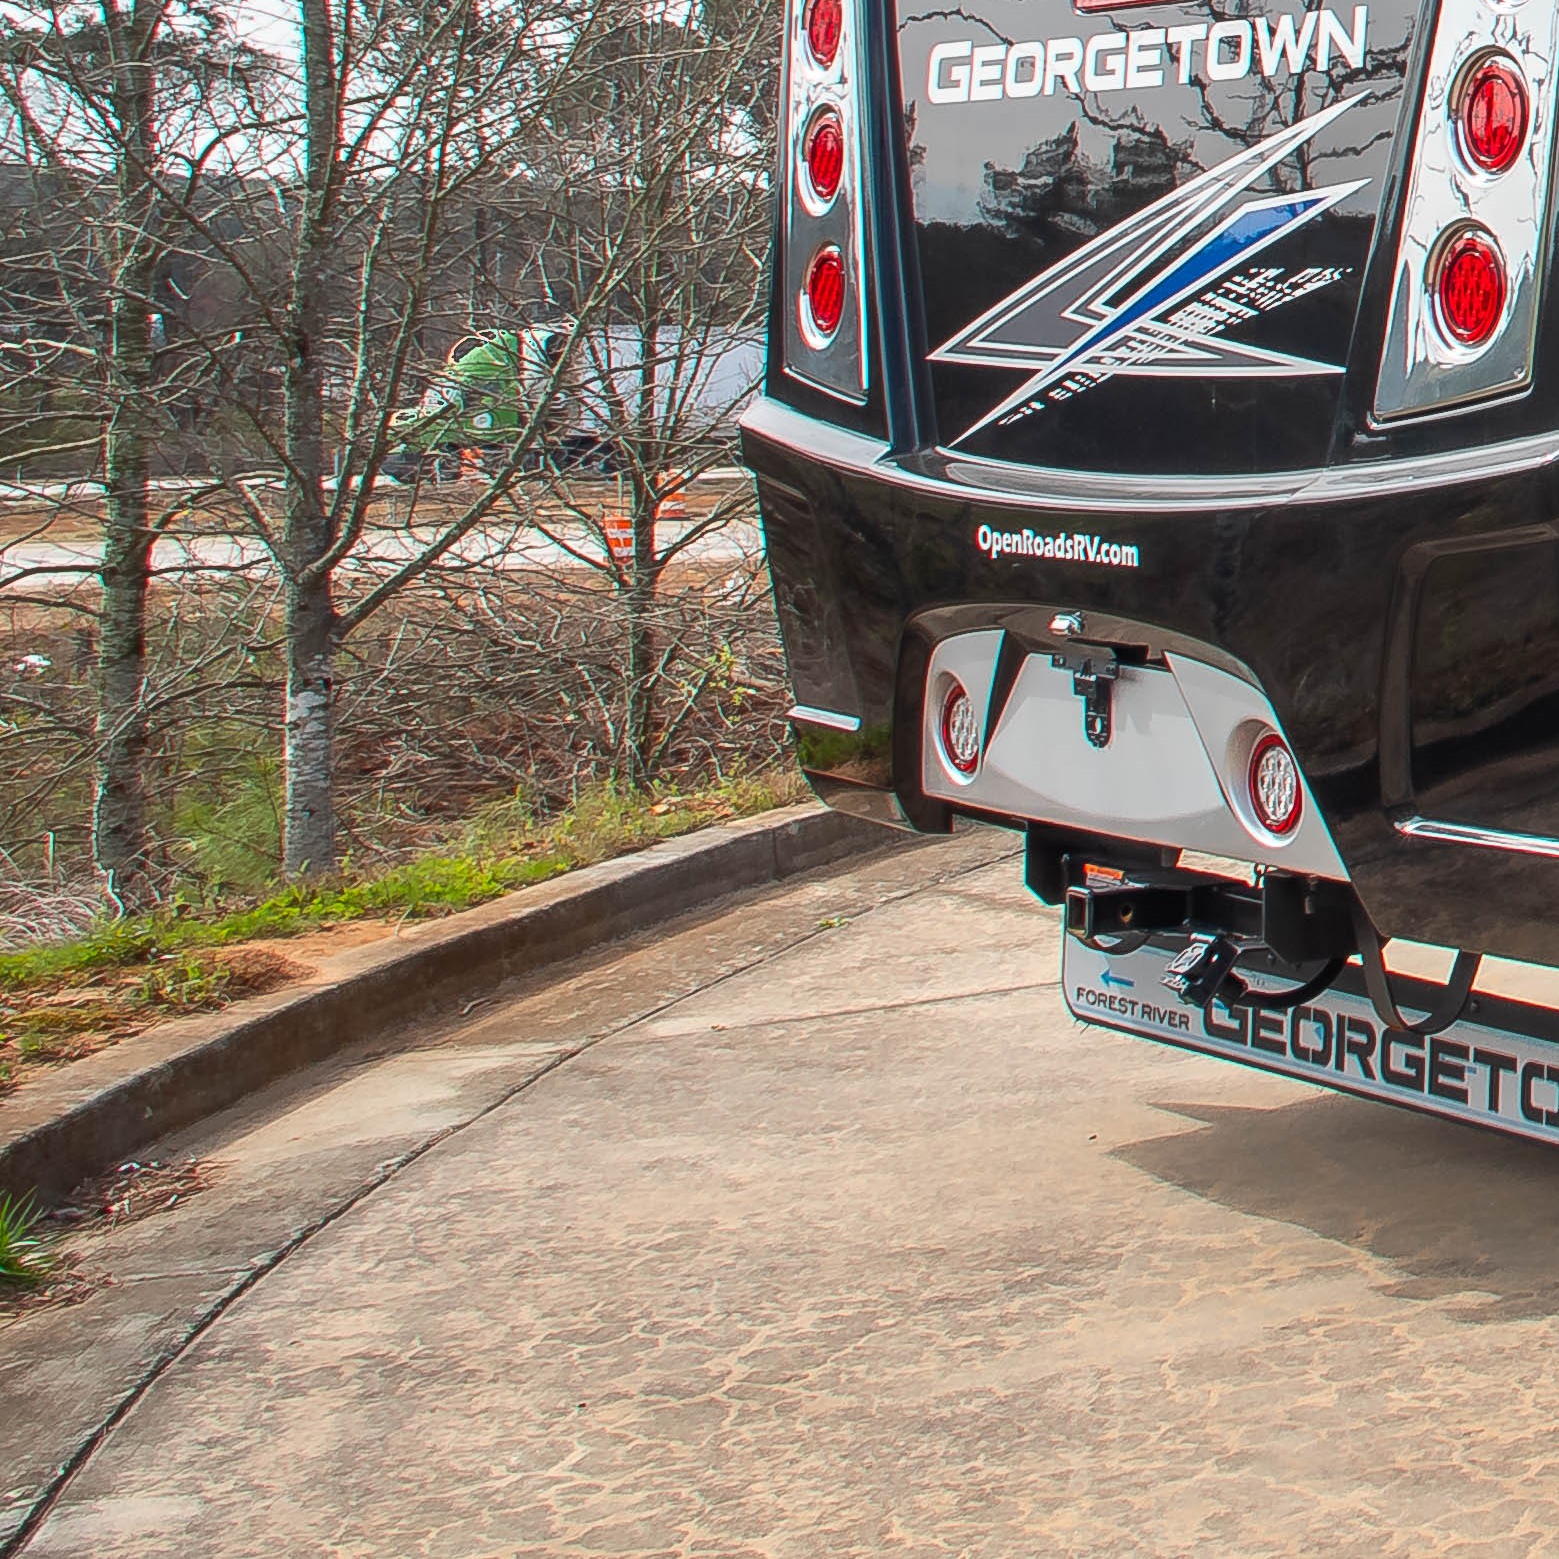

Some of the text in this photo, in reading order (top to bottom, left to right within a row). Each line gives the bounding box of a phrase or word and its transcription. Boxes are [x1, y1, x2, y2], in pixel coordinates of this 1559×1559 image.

[926, 5, 1368, 105] GEORGETOWN
[976, 524, 1139, 567] OpenRoadsRV.com
[1076, 986, 1191, 1031] FOREST RIVER
